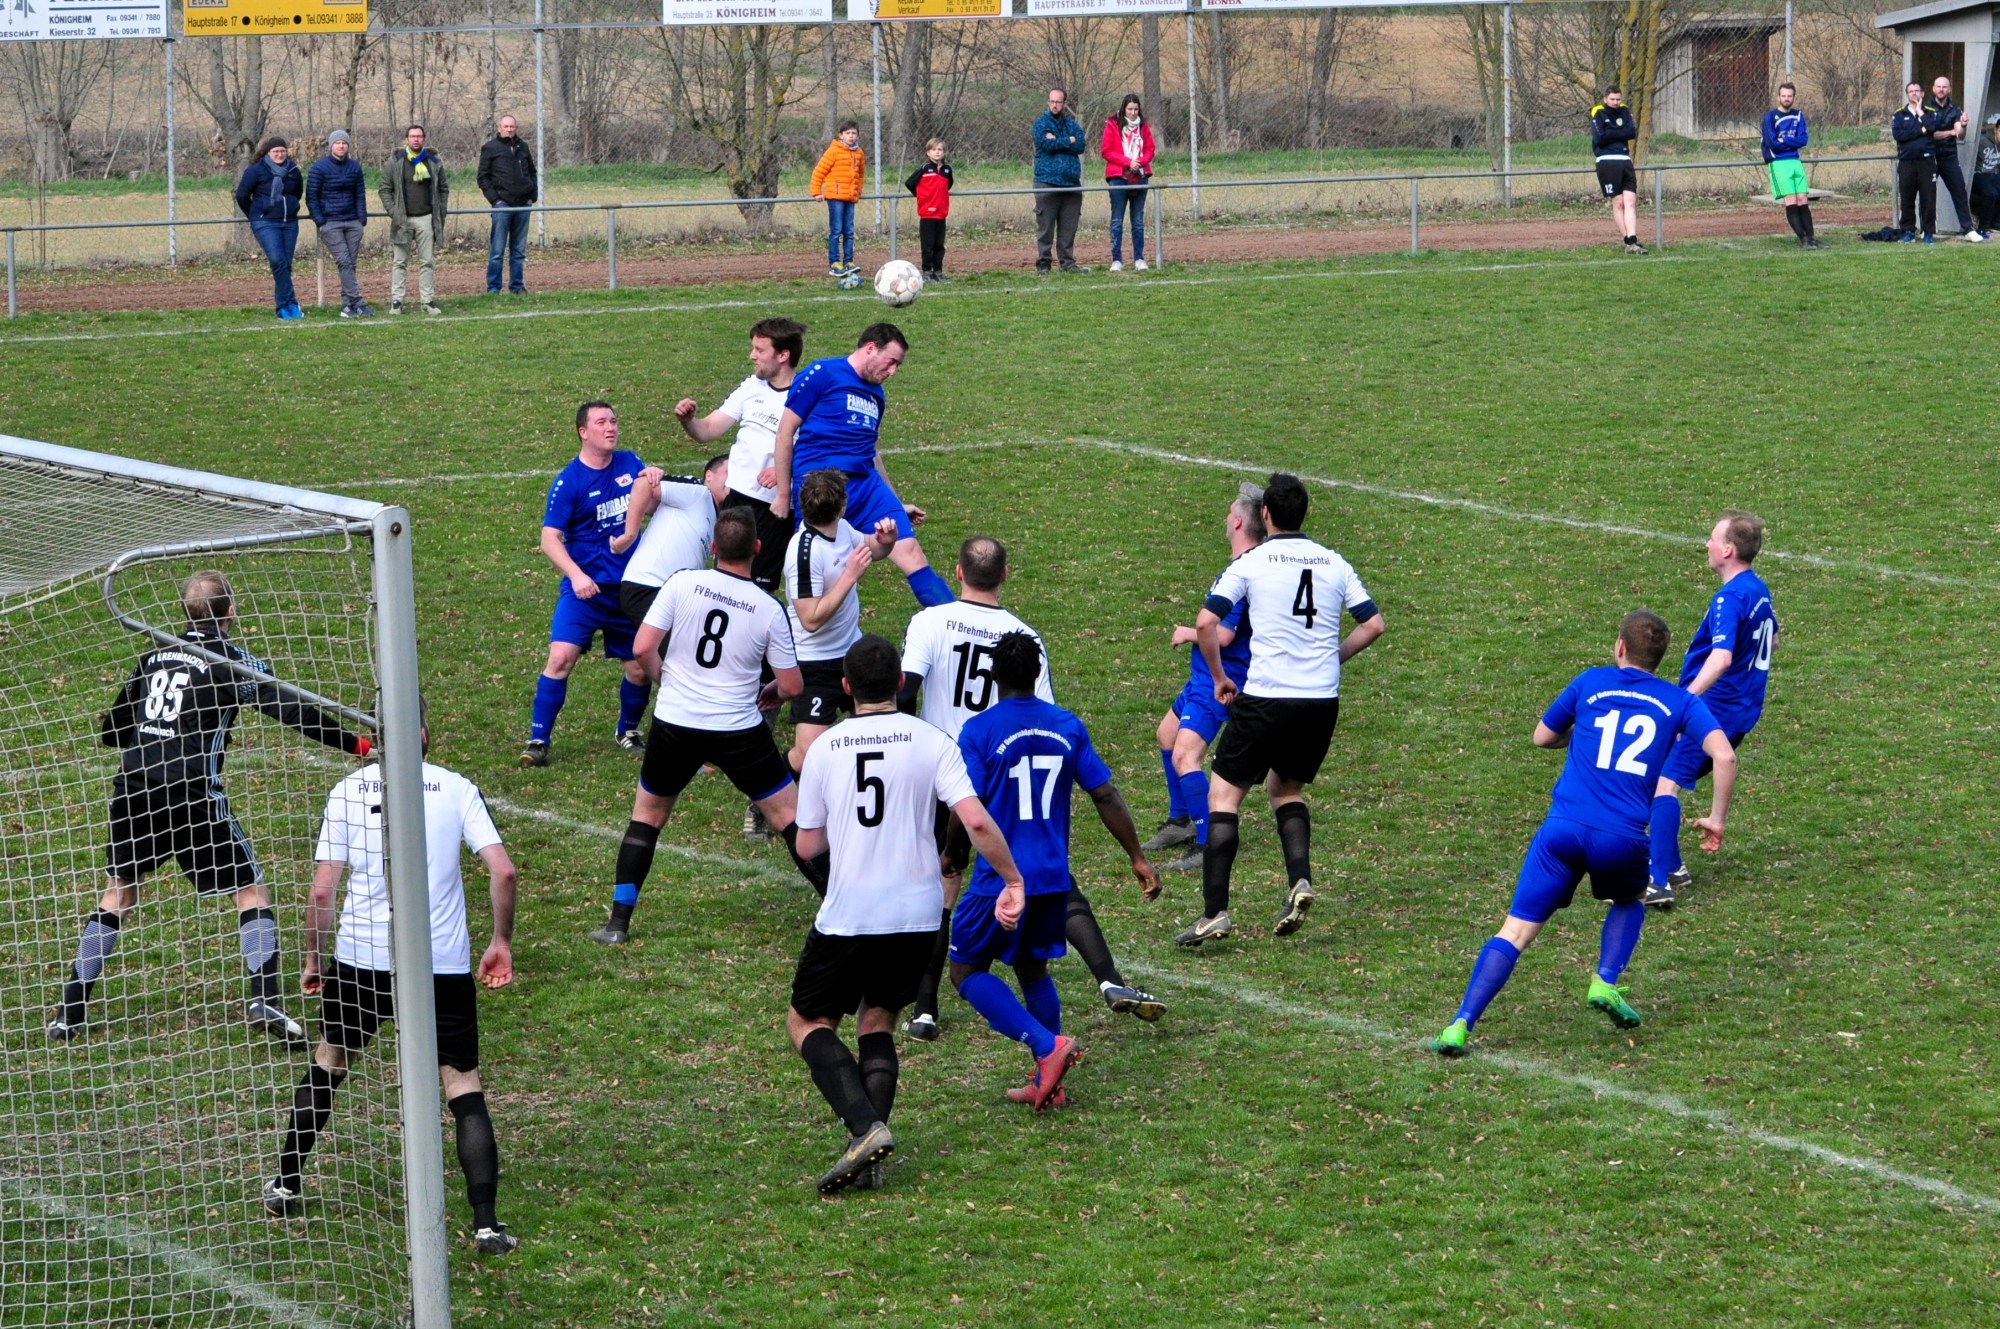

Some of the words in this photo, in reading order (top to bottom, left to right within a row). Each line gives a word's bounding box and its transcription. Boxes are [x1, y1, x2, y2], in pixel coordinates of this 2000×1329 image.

[716, 6, 777, 18] KÖNIGHEIM
[898, 6, 920, 14] Verkauf
[1034, 0, 1095, 9] HAUPTSTRASSE
[49, 14, 92, 24] KÖNIGHEIM
[188, 16, 228, 29] Hauptstraße
[231, 16, 237, 26] 17
[254, 15, 290, 28] Königheim
[345, 13, 363, 24] 3888
[1605, 184, 1614, 194] 12
[1268, 554, 1278, 564] FV
[1280, 554, 1331, 566] Brehmbachtal
[694, 584, 704, 595] FV
[704, 587, 756, 614] Brehmbachtal
[1292, 569, 1318, 629] 4
[695, 608, 730, 669] 8
[946, 619, 957, 631] FV
[958, 622, 1003, 640] Brehmbach
[1748, 617, 1774, 672] 10
[953, 641, 997, 712] 15
[144, 669, 190, 722] 85
[809, 697, 823, 717] 2
[831, 738, 841, 752] FV
[843, 732, 912, 748] Brehmbachtal
[1594, 709, 1657, 777] 12
[358, 782, 370, 794] FV
[856, 751, 885, 828] 5
[1008, 755, 1064, 821] 17
